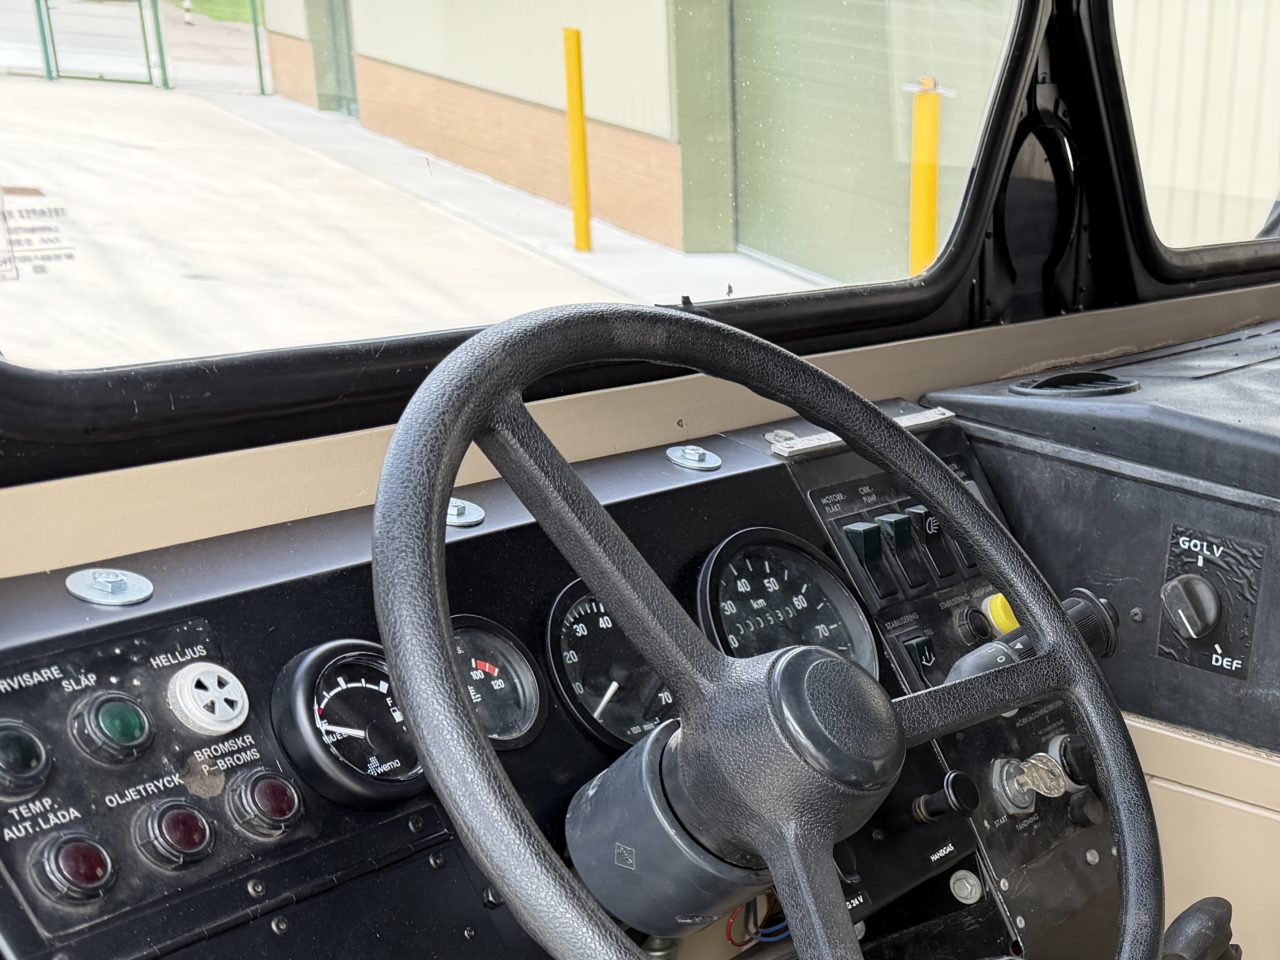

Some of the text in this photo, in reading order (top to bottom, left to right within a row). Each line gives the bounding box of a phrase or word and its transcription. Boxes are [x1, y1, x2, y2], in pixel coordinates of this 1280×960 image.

[1179, 537, 1224, 558] GOLV
[736, 578, 751, 594] 40
[764, 578, 779, 593] 50
[721, 600, 737, 615] 30
[750, 597, 767, 610] km
[792, 595, 808, 610] 60
[573, 623, 588, 637] 30
[599, 616, 613, 630] 40
[814, 623, 829, 638] 70
[150, 645, 207, 669] HELLJUS
[563, 651, 579, 664] 20
[1211, 654, 1242, 671] DEF
[61, 669, 97, 692] SLÄP
[470, 670, 485, 681] 100
[491, 678, 505, 690] 120
[572, 682, 585, 695] 10
[658, 691, 673, 705] 70
[193, 735, 256, 763] BROMSKR
[375, 757, 401, 775] wema
[105, 774, 184, 808] OLJETRYCK
[8, 798, 60, 821] TEMP.
[930, 843, 955, 862] HANDGAS
